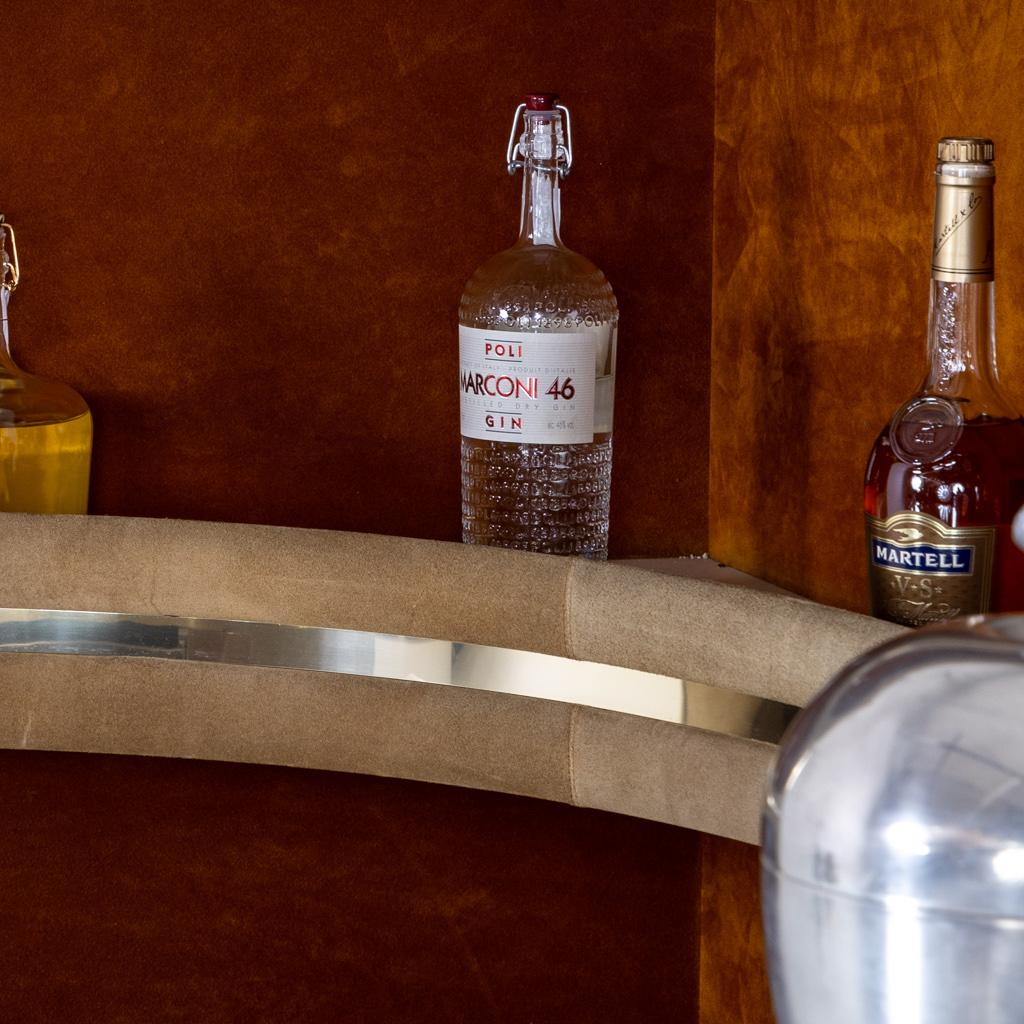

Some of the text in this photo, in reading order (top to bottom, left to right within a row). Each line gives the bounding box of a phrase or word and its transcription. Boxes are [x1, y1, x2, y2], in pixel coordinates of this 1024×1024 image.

[485, 343, 522, 358] POLI
[545, 376, 575, 400] 46
[485, 414, 522, 429] GIN
[876, 545, 965, 568] MARTELL
